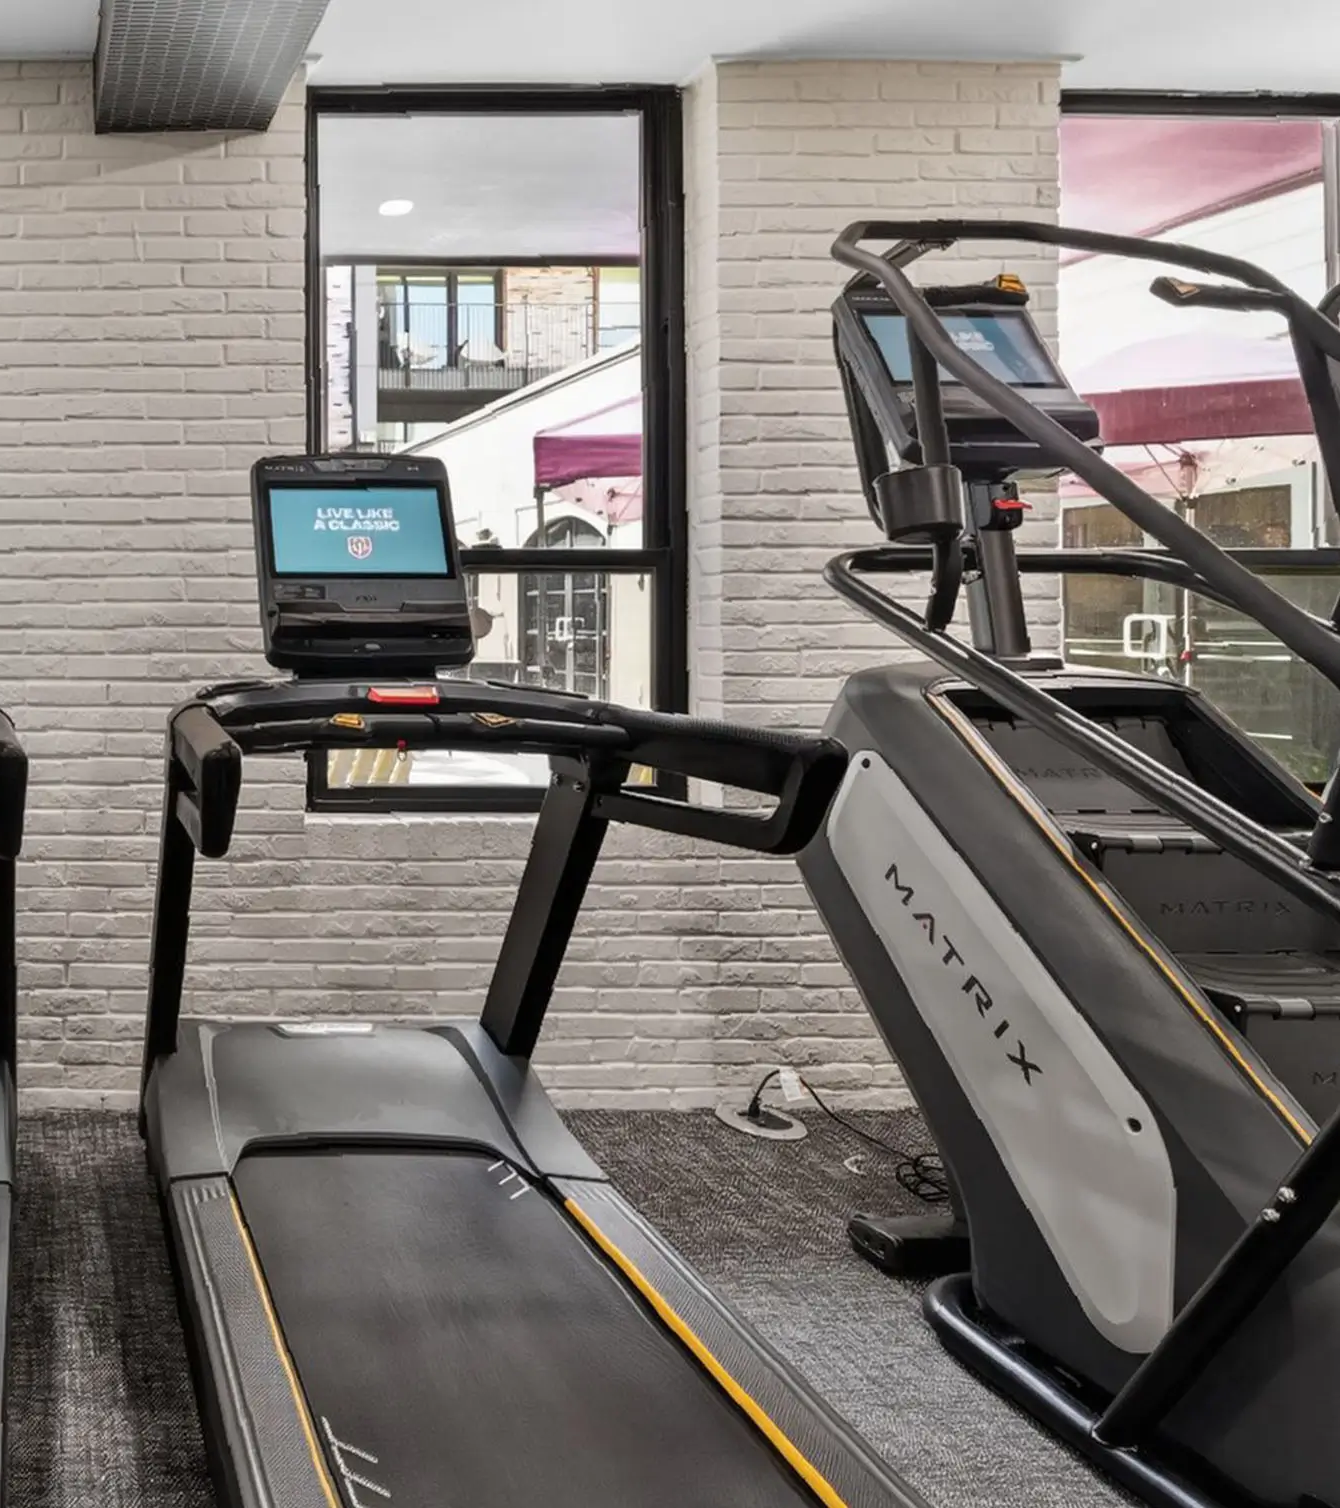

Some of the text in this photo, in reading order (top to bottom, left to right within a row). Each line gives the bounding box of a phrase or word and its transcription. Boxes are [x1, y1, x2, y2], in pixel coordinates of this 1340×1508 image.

[316, 507, 394, 519] LIVE LIKE
[313, 519, 400, 531] A CLASSIC
[1160, 900, 1292, 918] MATRIX
[884, 863, 1044, 1087] MATRIX
